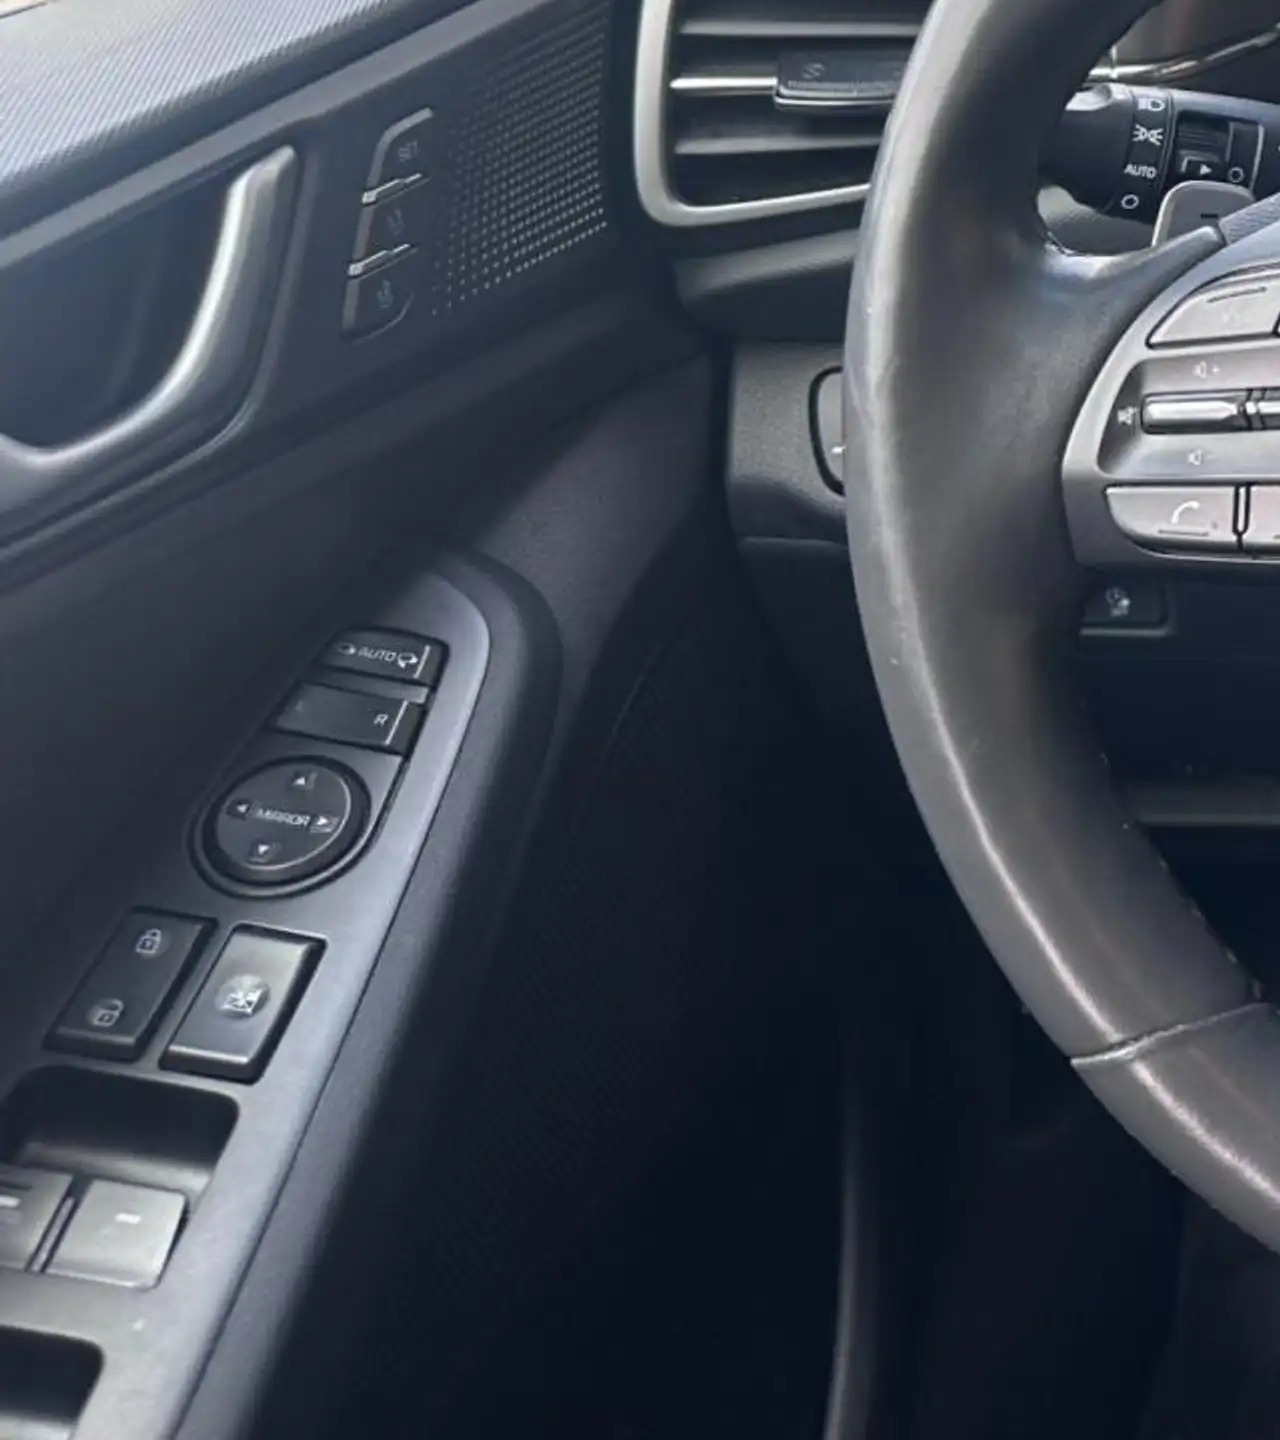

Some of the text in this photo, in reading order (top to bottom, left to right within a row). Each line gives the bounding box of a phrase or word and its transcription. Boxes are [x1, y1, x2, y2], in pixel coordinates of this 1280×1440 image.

[1124, 163, 1157, 179] AUTO
[357, 645, 398, 662] AUTO
[374, 713, 389, 727] R
